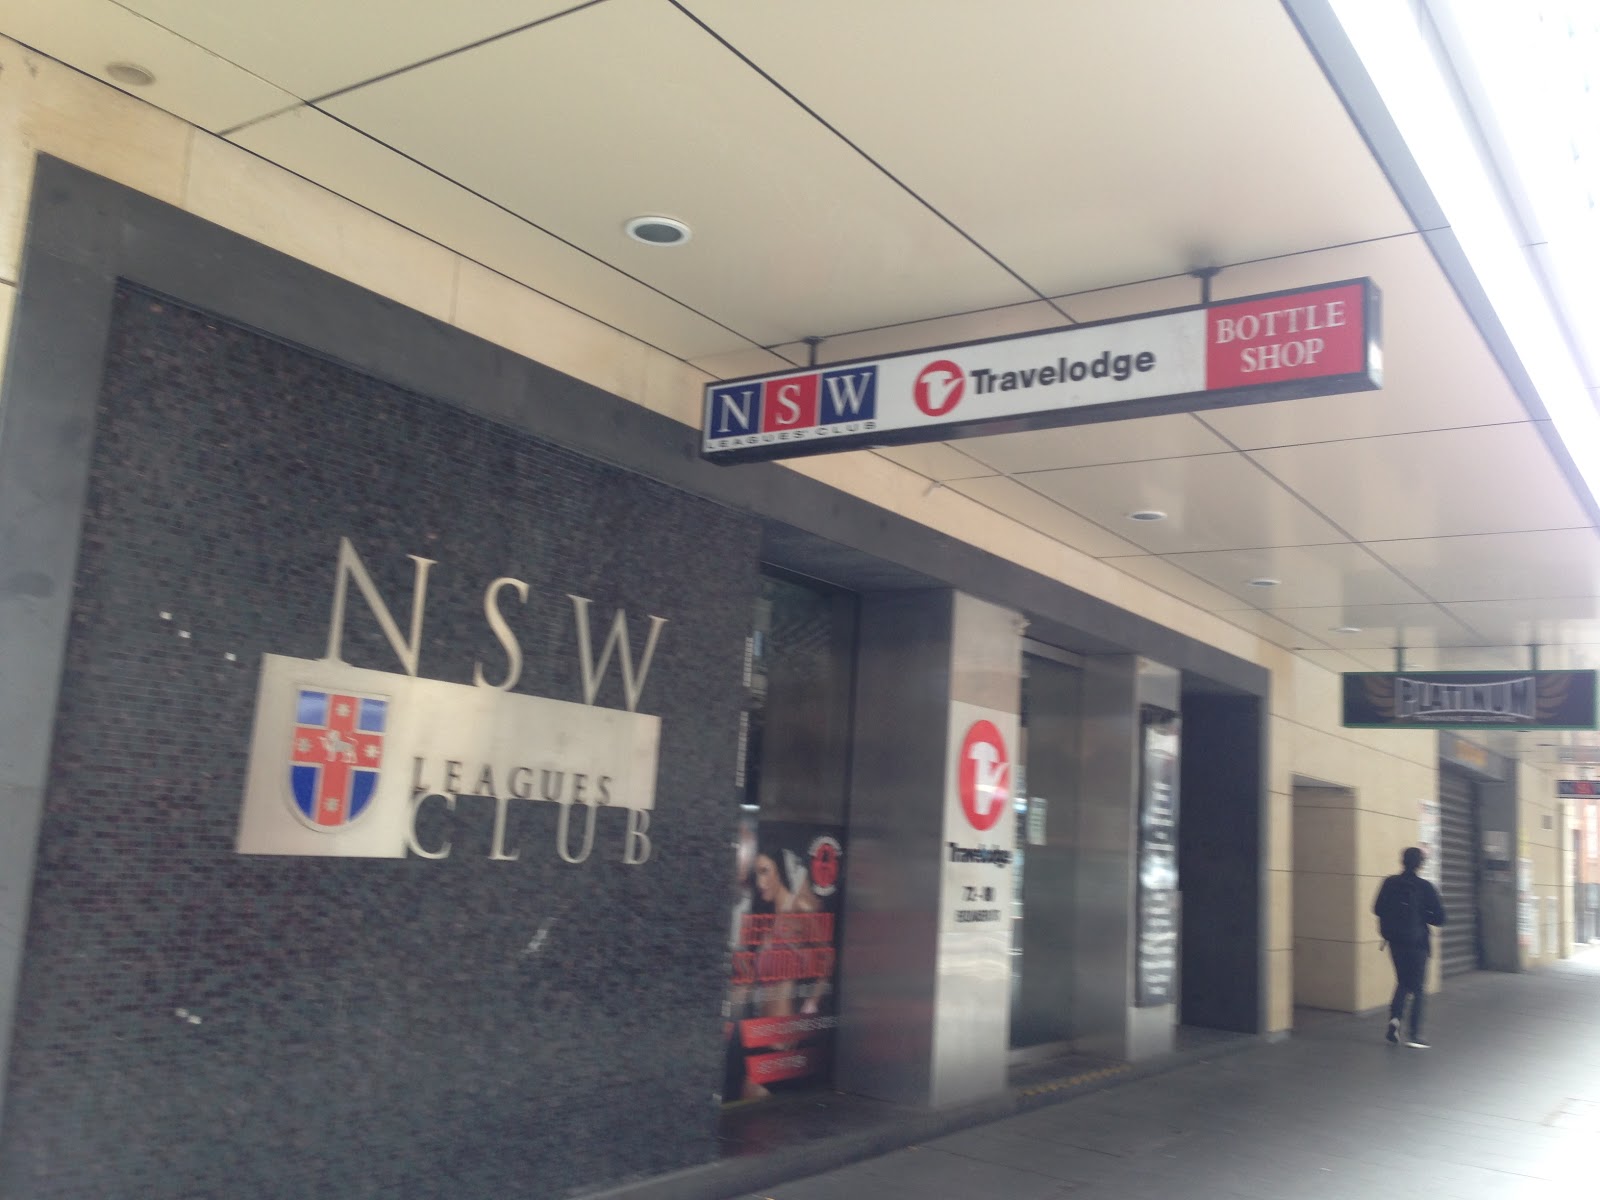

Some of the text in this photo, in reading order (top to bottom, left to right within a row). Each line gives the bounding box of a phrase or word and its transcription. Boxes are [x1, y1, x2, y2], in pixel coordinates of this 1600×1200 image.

[1215, 301, 1346, 344] BOTTLE
[970, 351, 1156, 395] Travelodge
[1240, 338, 1324, 373] SHOP
[717, 372, 873, 433] NSW
[816, 420, 877, 436] CLUB
[317, 536, 668, 711] NSW
[410, 756, 613, 806] LEAGUES
[405, 792, 652, 865] CLUB
